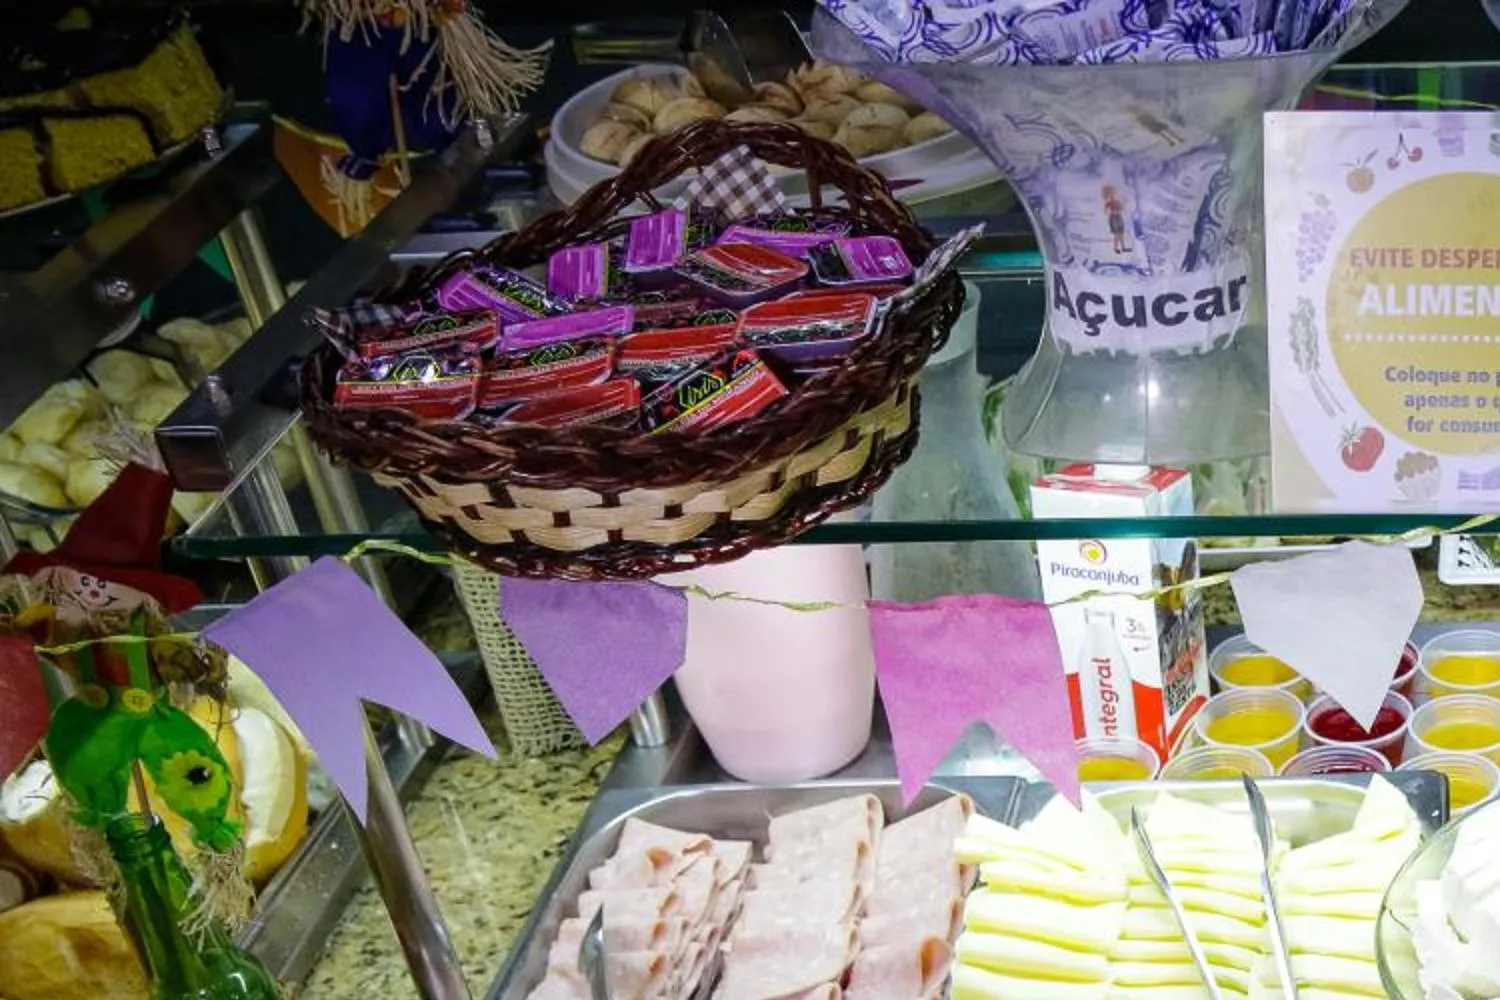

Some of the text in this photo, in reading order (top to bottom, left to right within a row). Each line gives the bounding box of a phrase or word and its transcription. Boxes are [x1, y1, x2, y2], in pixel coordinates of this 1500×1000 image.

[1350, 248, 1414, 269] EVITE
[1053, 270, 1247, 336] Açucar
[1385, 366, 1461, 387] Coloque
[1465, 369, 1490, 384] no
[1404, 394, 1470, 411] apenas
[1476, 396, 1487, 409] o
[1407, 416, 1434, 432] for
[1050, 562, 1139, 586] Piracanjuba
